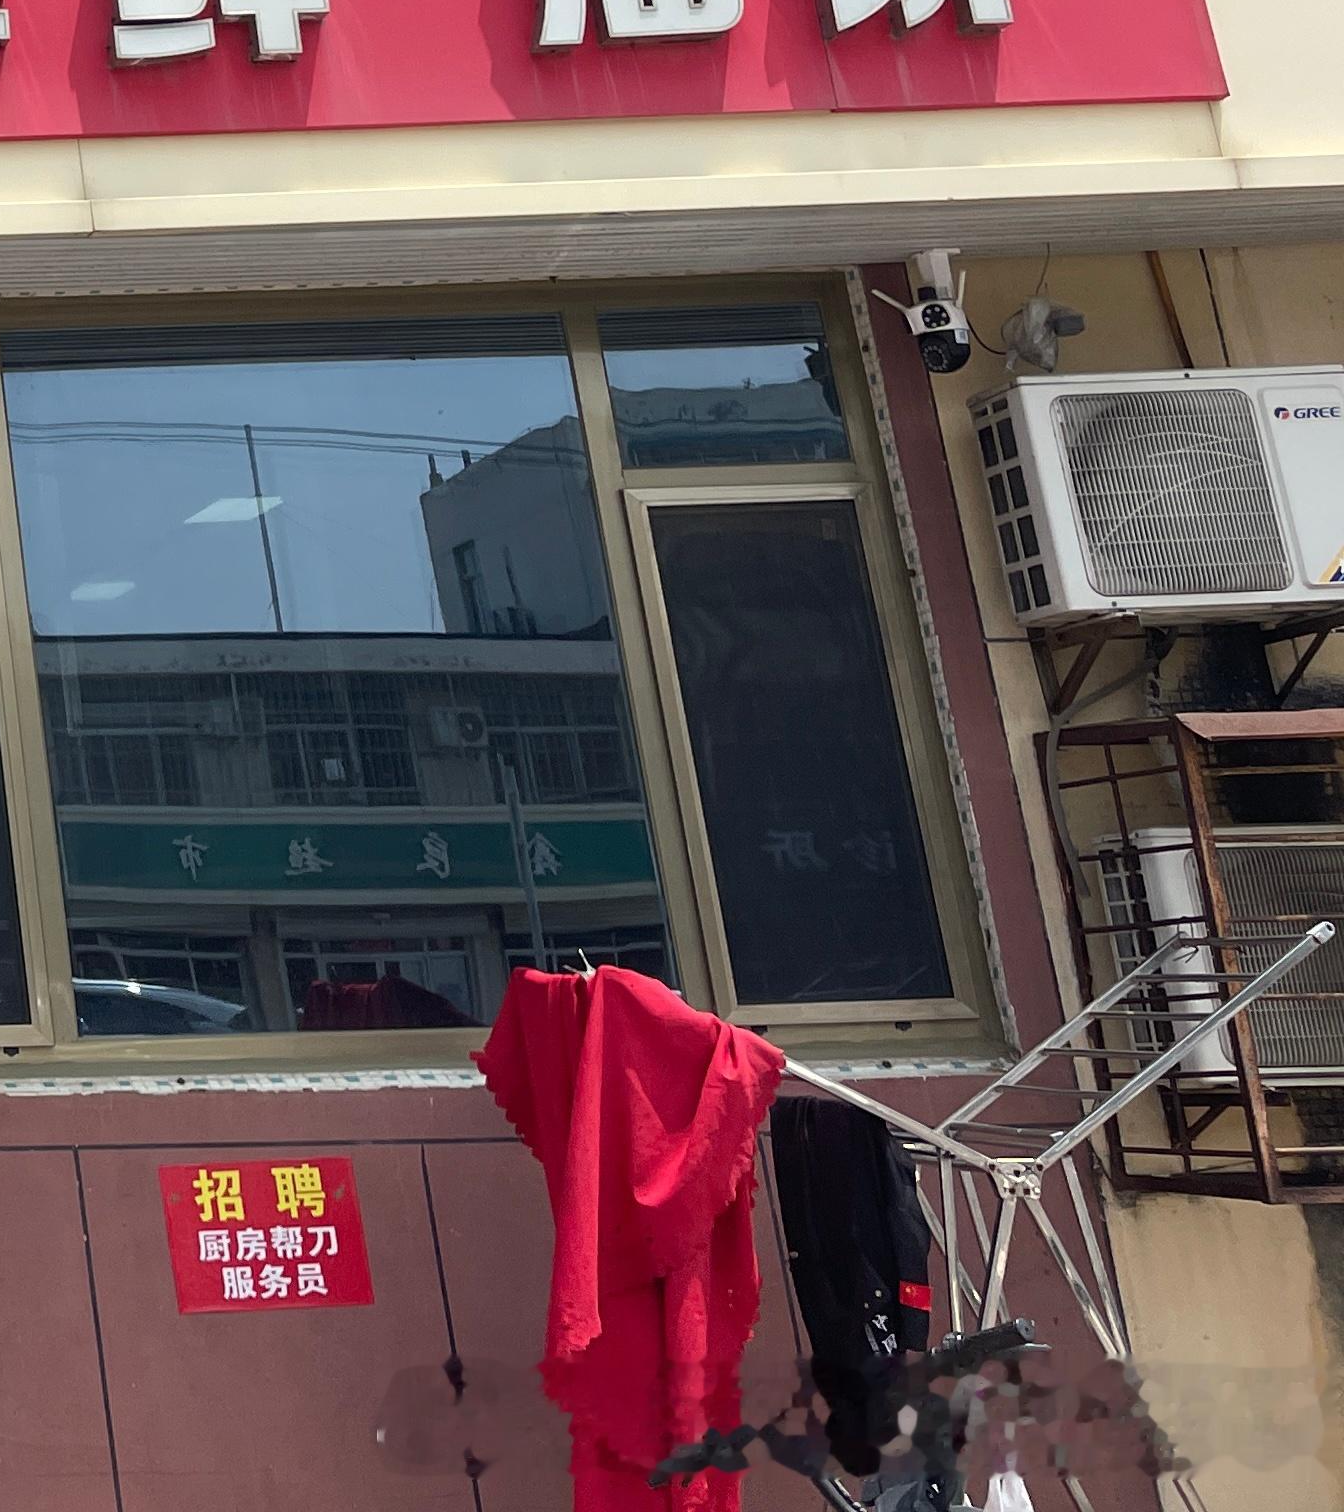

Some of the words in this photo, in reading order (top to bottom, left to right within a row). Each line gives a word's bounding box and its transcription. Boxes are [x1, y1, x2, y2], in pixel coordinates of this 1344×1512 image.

[1294, 406, 1341, 419] GREE
[193, 1163, 326, 1221] 招聘
[198, 1225, 338, 1262] 厨房帮刀
[222, 1263, 328, 1299] 服务员
